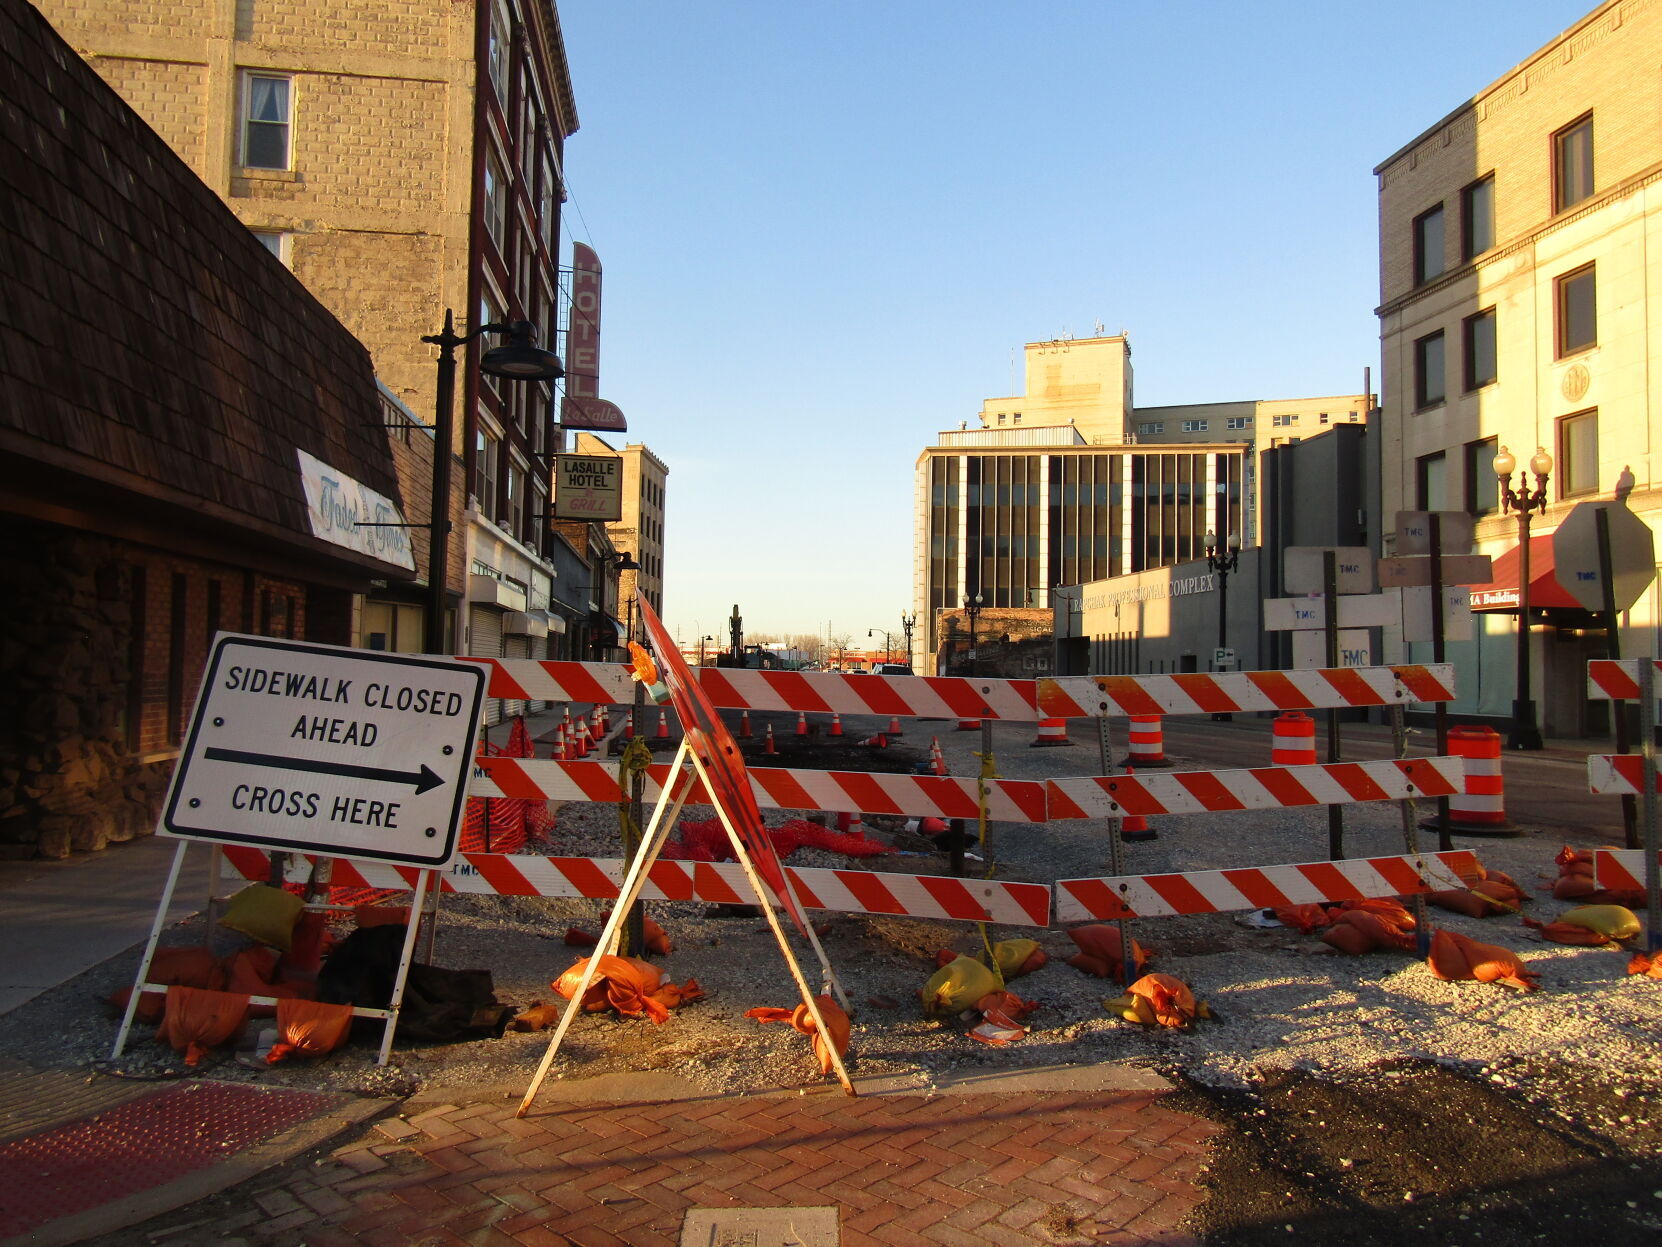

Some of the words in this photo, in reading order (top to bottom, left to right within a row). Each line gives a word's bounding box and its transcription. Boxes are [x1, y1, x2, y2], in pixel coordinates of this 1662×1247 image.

[576, 262, 598, 397] HOTEL
[566, 407, 618, 422] LaSalle
[564, 461, 614, 475] LASALLE
[568, 474, 608, 487] HOTEL
[569, 498, 606, 511] GRILL
[1404, 527, 1424, 537] TMC
[1340, 565, 1360, 574] TMC
[1577, 572, 1596, 581] TMC
[1108, 584, 1166, 607] PROFESSIONAL
[1169, 574, 1214, 598] COMPLEX
[1483, 590, 1520, 605] Building
[1296, 610, 1316, 619] TMC
[1216, 650, 1225, 663] P
[1341, 649, 1368, 666] TMC
[226, 666, 353, 704] SIDEWALK
[365, 683, 462, 717] CLOSED
[291, 715, 378, 747] AHEAD
[473, 767, 492, 779] MC
[232, 784, 320, 819] CROSS
[331, 796, 400, 829] HERE
